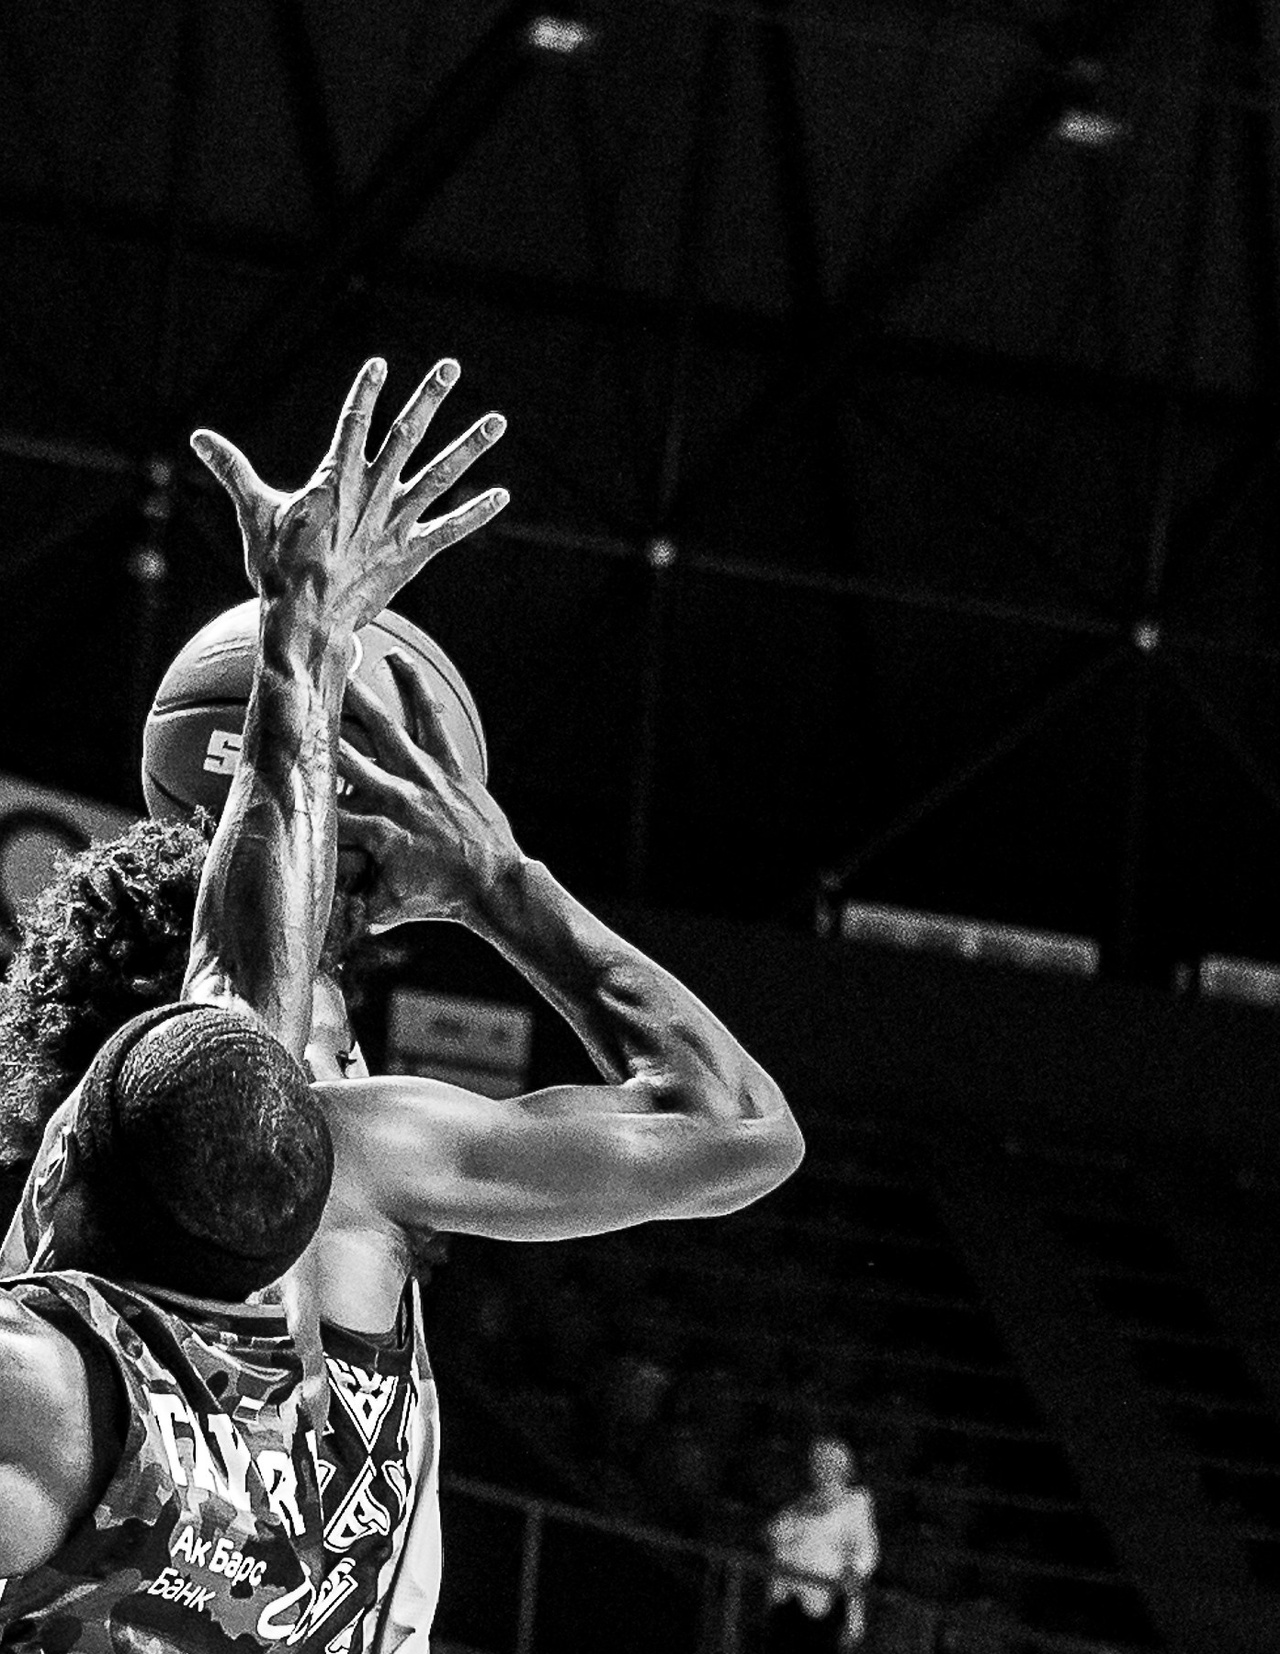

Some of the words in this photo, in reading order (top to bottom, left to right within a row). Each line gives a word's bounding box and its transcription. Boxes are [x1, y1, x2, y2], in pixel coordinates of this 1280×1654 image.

[171, 1525, 212, 1568] Ак
[208, 1538, 267, 1587] Барс
[147, 1567, 216, 1612] Банк
